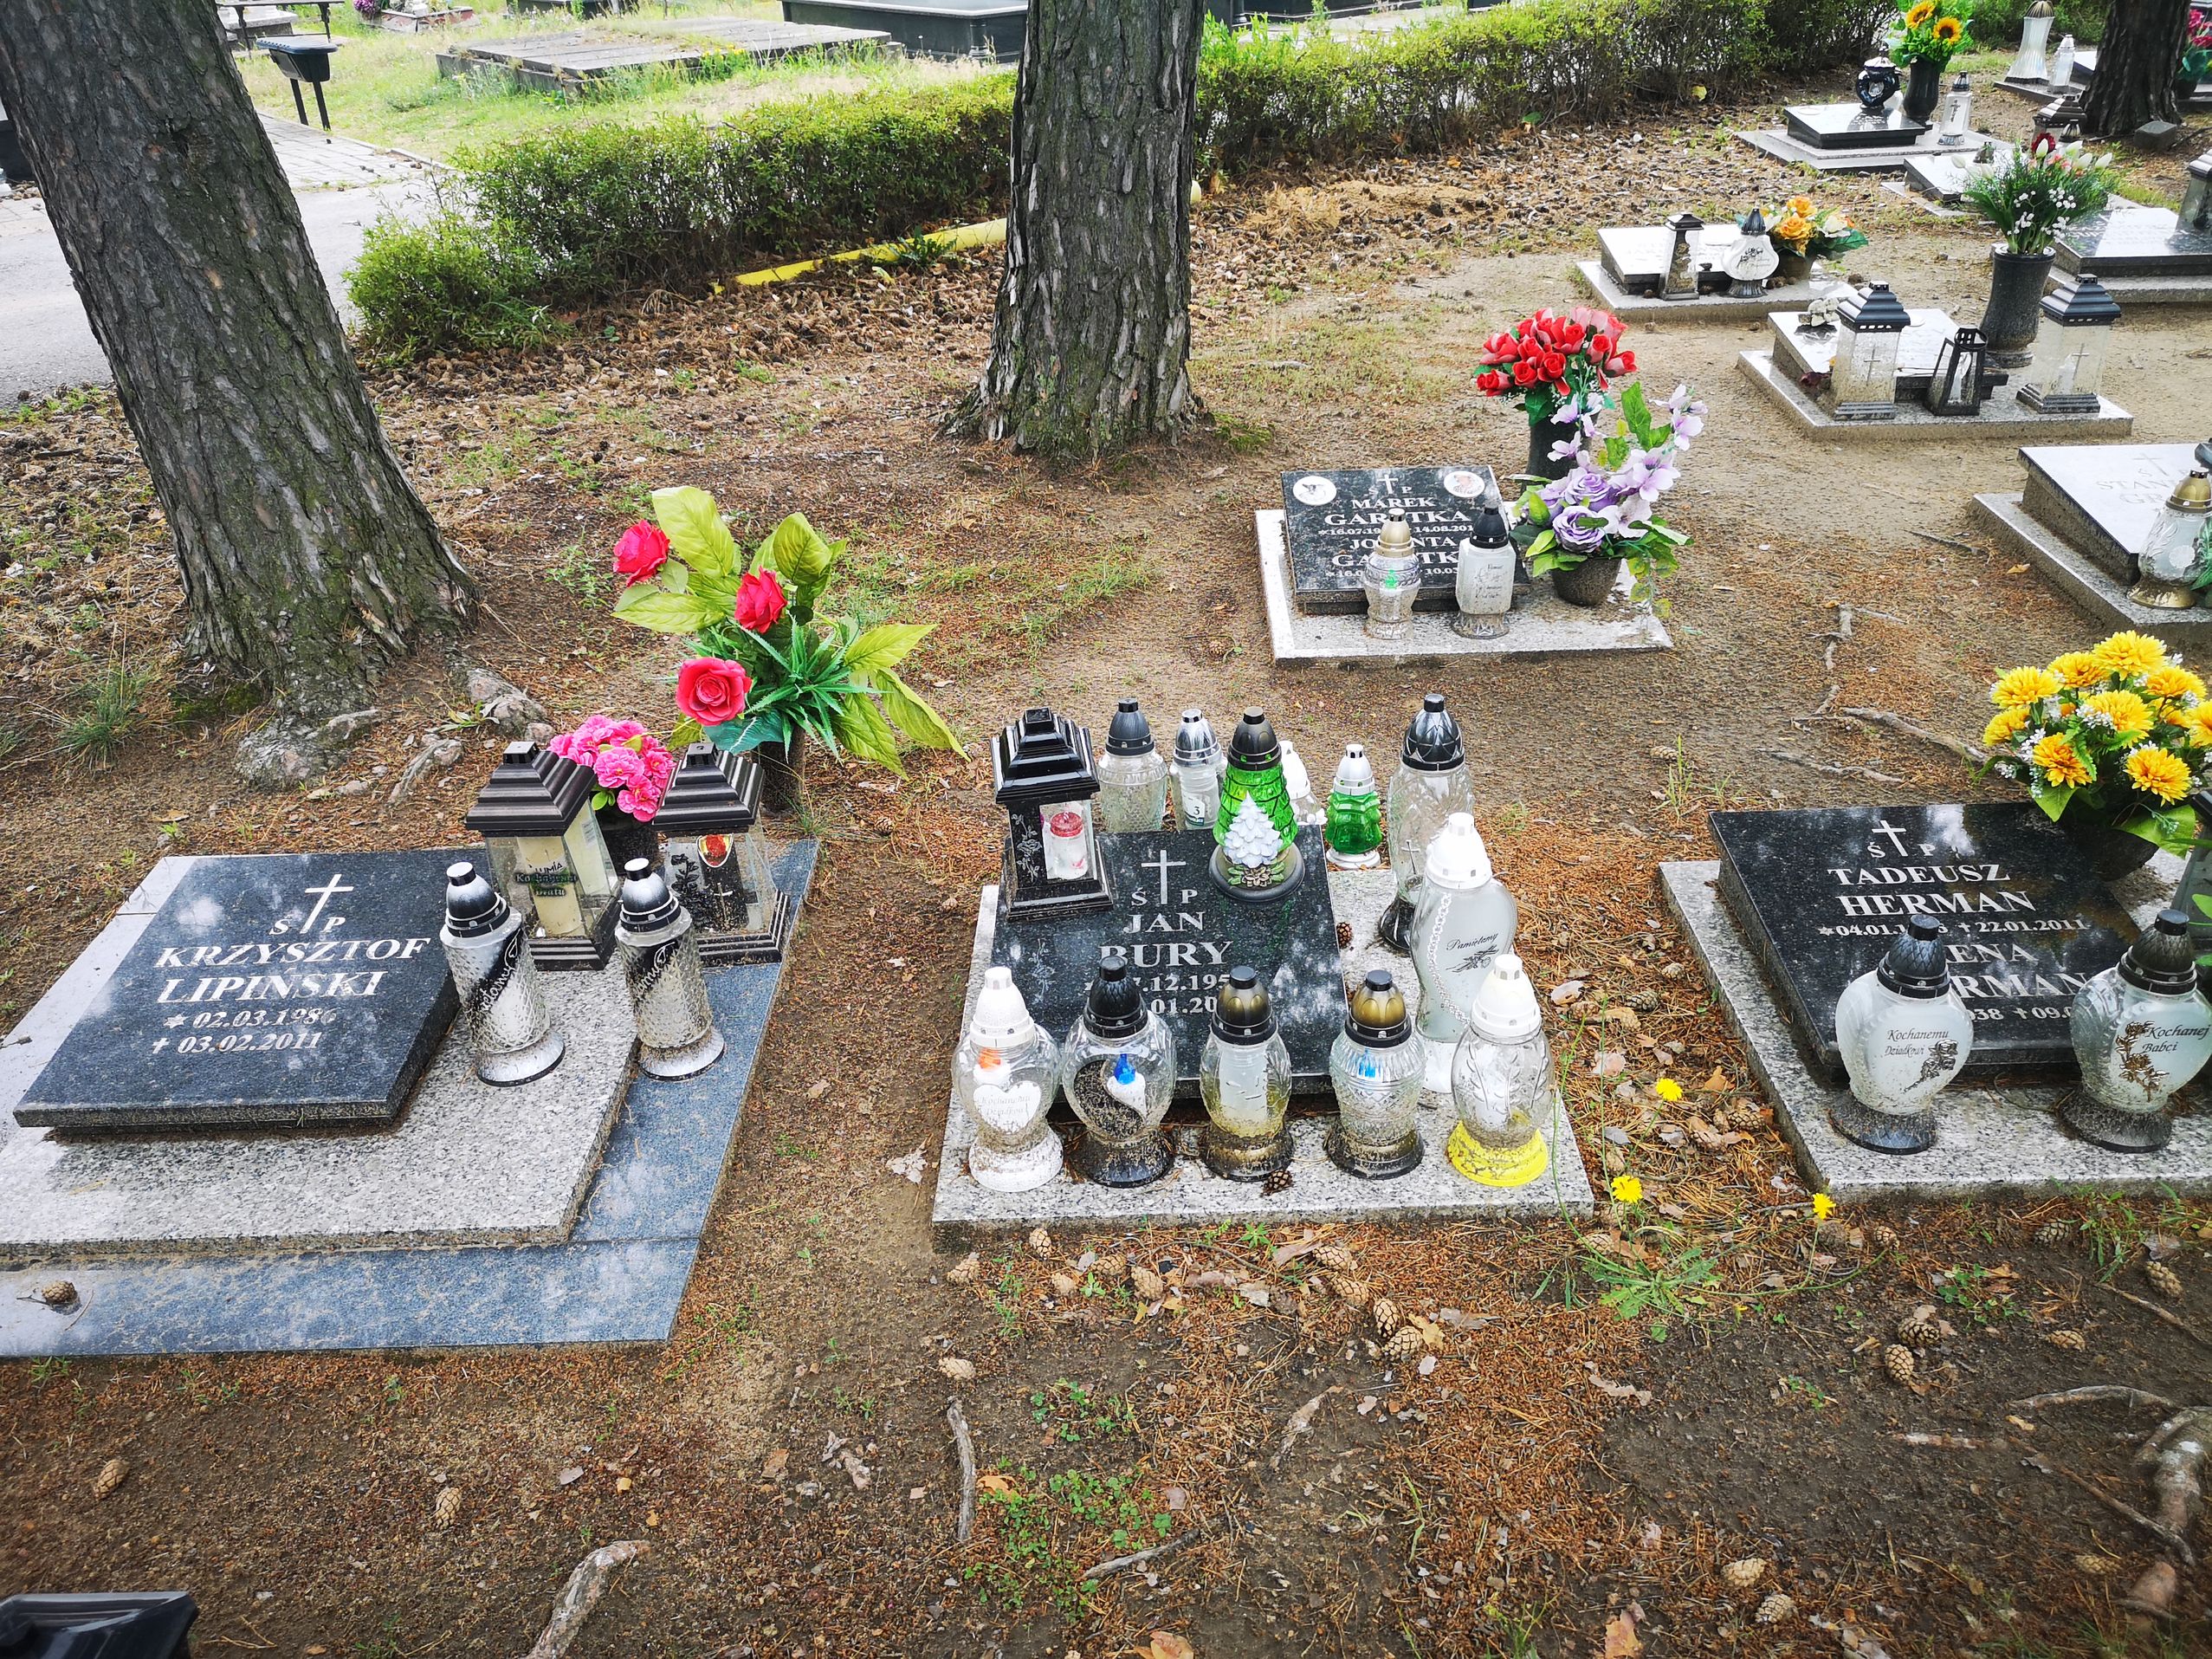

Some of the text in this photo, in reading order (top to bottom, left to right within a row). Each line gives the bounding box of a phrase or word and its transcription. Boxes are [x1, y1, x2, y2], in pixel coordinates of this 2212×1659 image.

[1351, 496, 1437, 509] MAREK
[1324, 510, 1472, 525] GARTKA
[1349, 536, 1458, 549] JONTA
[1331, 551, 1459, 567] GATK
[1193, 806, 1200, 815] 3
[1916, 844, 1937, 857] P
[1827, 864, 2011, 885] TADEUSZ
[1130, 886, 1198, 906] Ś P
[1834, 891, 2037, 917] HERMAN
[320, 917, 346, 933] P
[1122, 911, 1206, 934] JAN
[1975, 918, 2091, 933] 22.01.2011
[152, 937, 431, 969] KRZYSZTOF
[1097, 940, 1234, 969] BURY
[1944, 943, 2040, 963] ENA
[156, 967, 389, 1004] LIPIŃSKI
[1950, 972, 2088, 999] RMAN
[1886, 1027, 1950, 1042] Kochanemu
[2144, 1024, 2211, 1040] Kochanej
[177, 1031, 323, 1054] 03.02.2011
[2140, 1040, 2179, 1054] Babci
